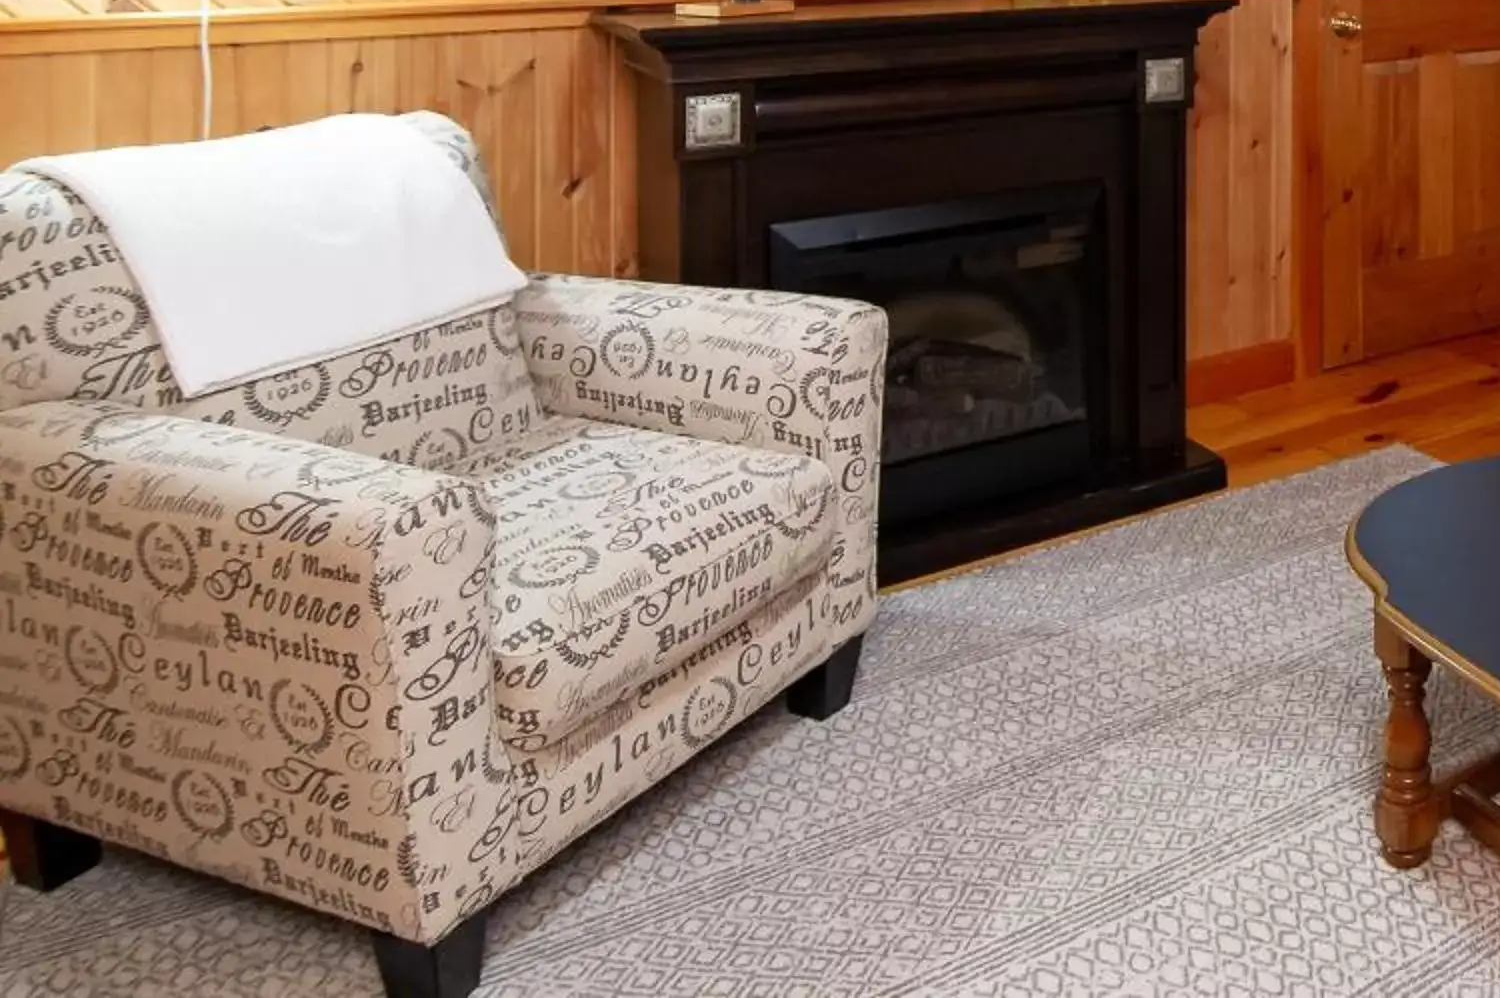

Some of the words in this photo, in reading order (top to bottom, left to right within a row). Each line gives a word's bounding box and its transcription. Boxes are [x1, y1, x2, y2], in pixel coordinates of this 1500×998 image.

[266, 378, 313, 402] 1926
[338, 342, 488, 399] Provence
[576, 379, 686, 428] Darjeeling
[655, 358, 797, 419] Ceylan
[360, 382, 488, 438] Darjeeling
[31, 451, 116, 506] Thé
[235, 490, 343, 547] Thé
[606, 478, 755, 552] Provence
[640, 502, 777, 575] Darjeeling
[203, 557, 362, 629] Provence
[637, 532, 774, 627] Provence
[118, 631, 264, 702] Ceylan
[221, 611, 362, 681] Darjeeling
[262, 756, 350, 812] Thé
[518, 709, 678, 836] Ceylan
[239, 809, 391, 893] Provence
[260, 856, 393, 931] Darjeeling
